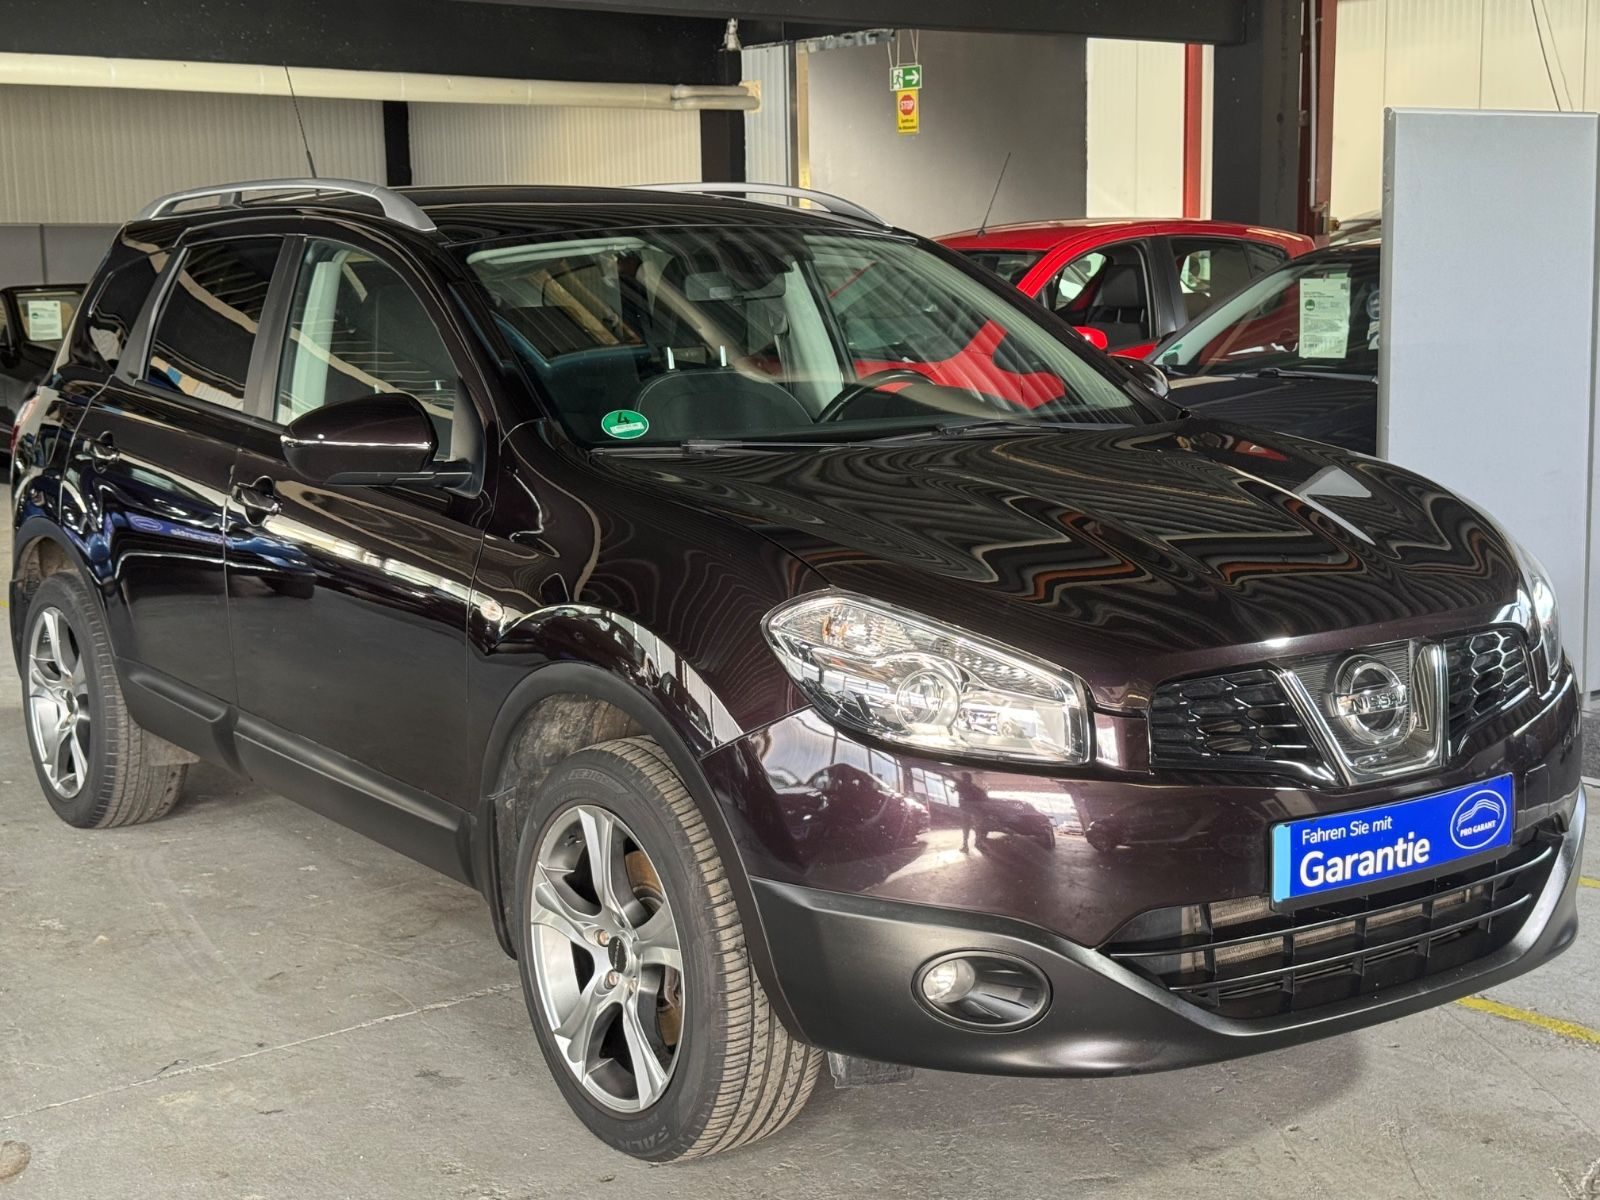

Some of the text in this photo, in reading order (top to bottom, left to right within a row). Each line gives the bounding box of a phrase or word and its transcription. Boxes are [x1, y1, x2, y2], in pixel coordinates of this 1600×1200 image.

[617, 412, 630, 424] 4
[1302, 816, 1393, 845] Fahren Sie mit
[1460, 820, 1497, 838] PRO GARANT
[1300, 831, 1431, 888] Garantie
